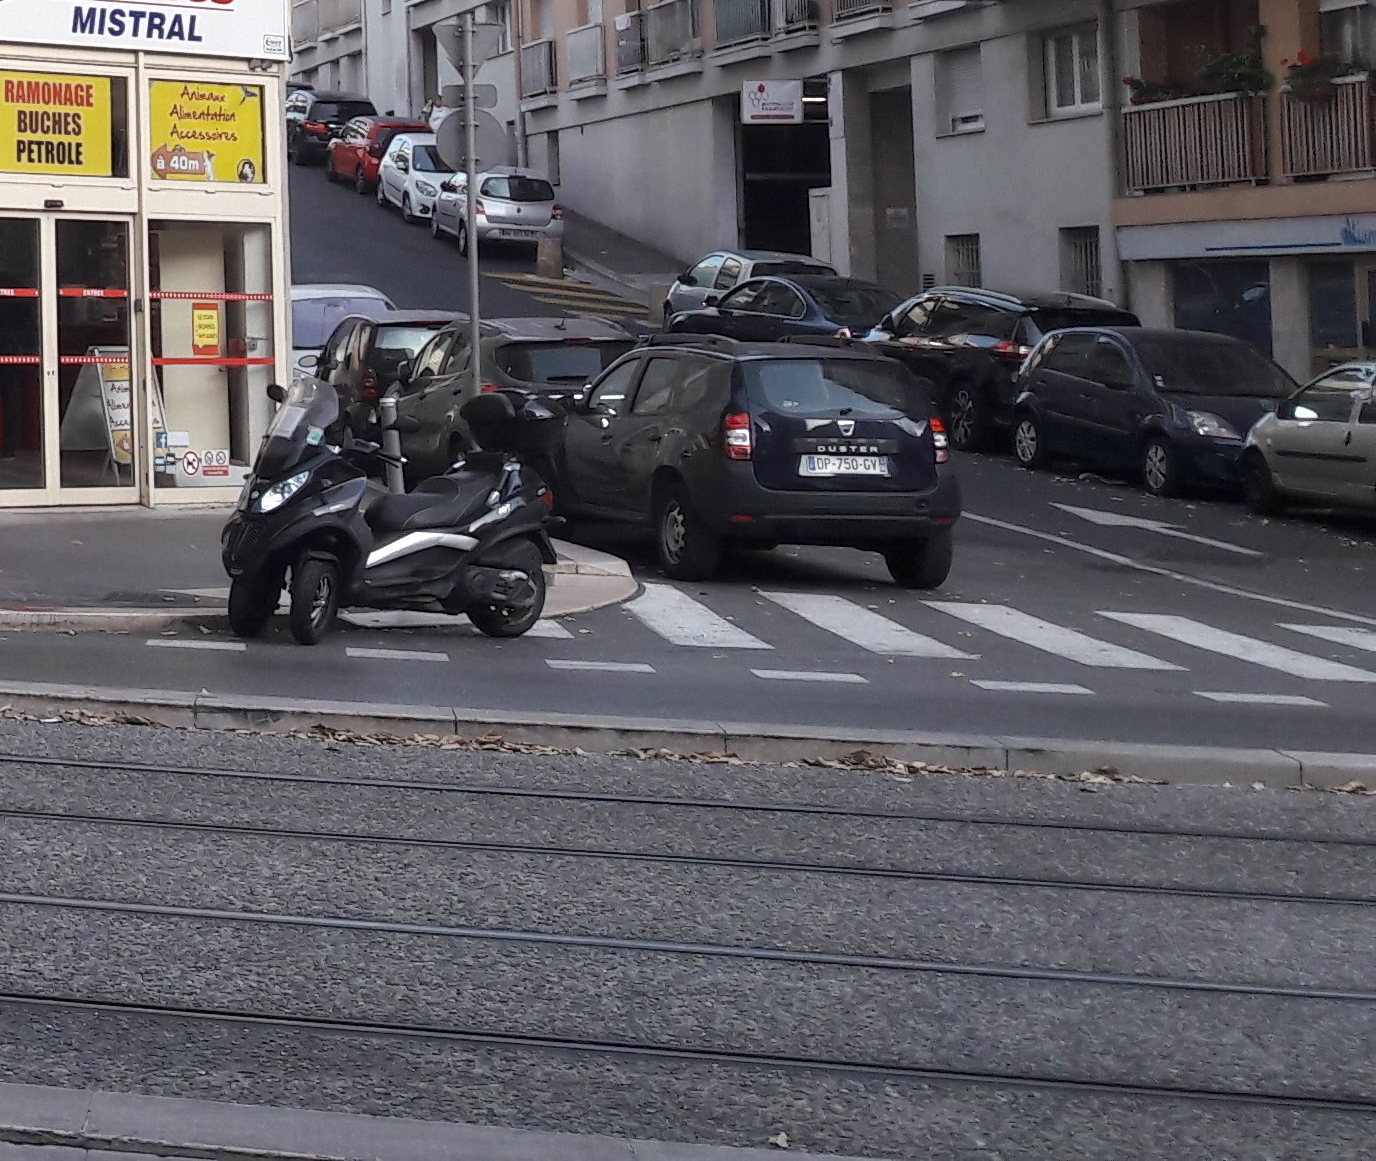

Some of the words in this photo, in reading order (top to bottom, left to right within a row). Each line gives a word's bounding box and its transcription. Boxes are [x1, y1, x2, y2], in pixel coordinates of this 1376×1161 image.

[71, 6, 203, 42] MISTRAL
[4, 79, 94, 107] RAMONAGE
[180, 85, 226, 103] Animaux
[169, 103, 236, 122] Alimentation
[16, 109, 82, 136] BUCHES
[170, 123, 238, 142] Accessoires
[16, 139, 83, 166] PETROLE
[156, 156, 165, 169] à
[170, 156, 200, 170] 40m
[817, 445, 878, 453] DUSTER
